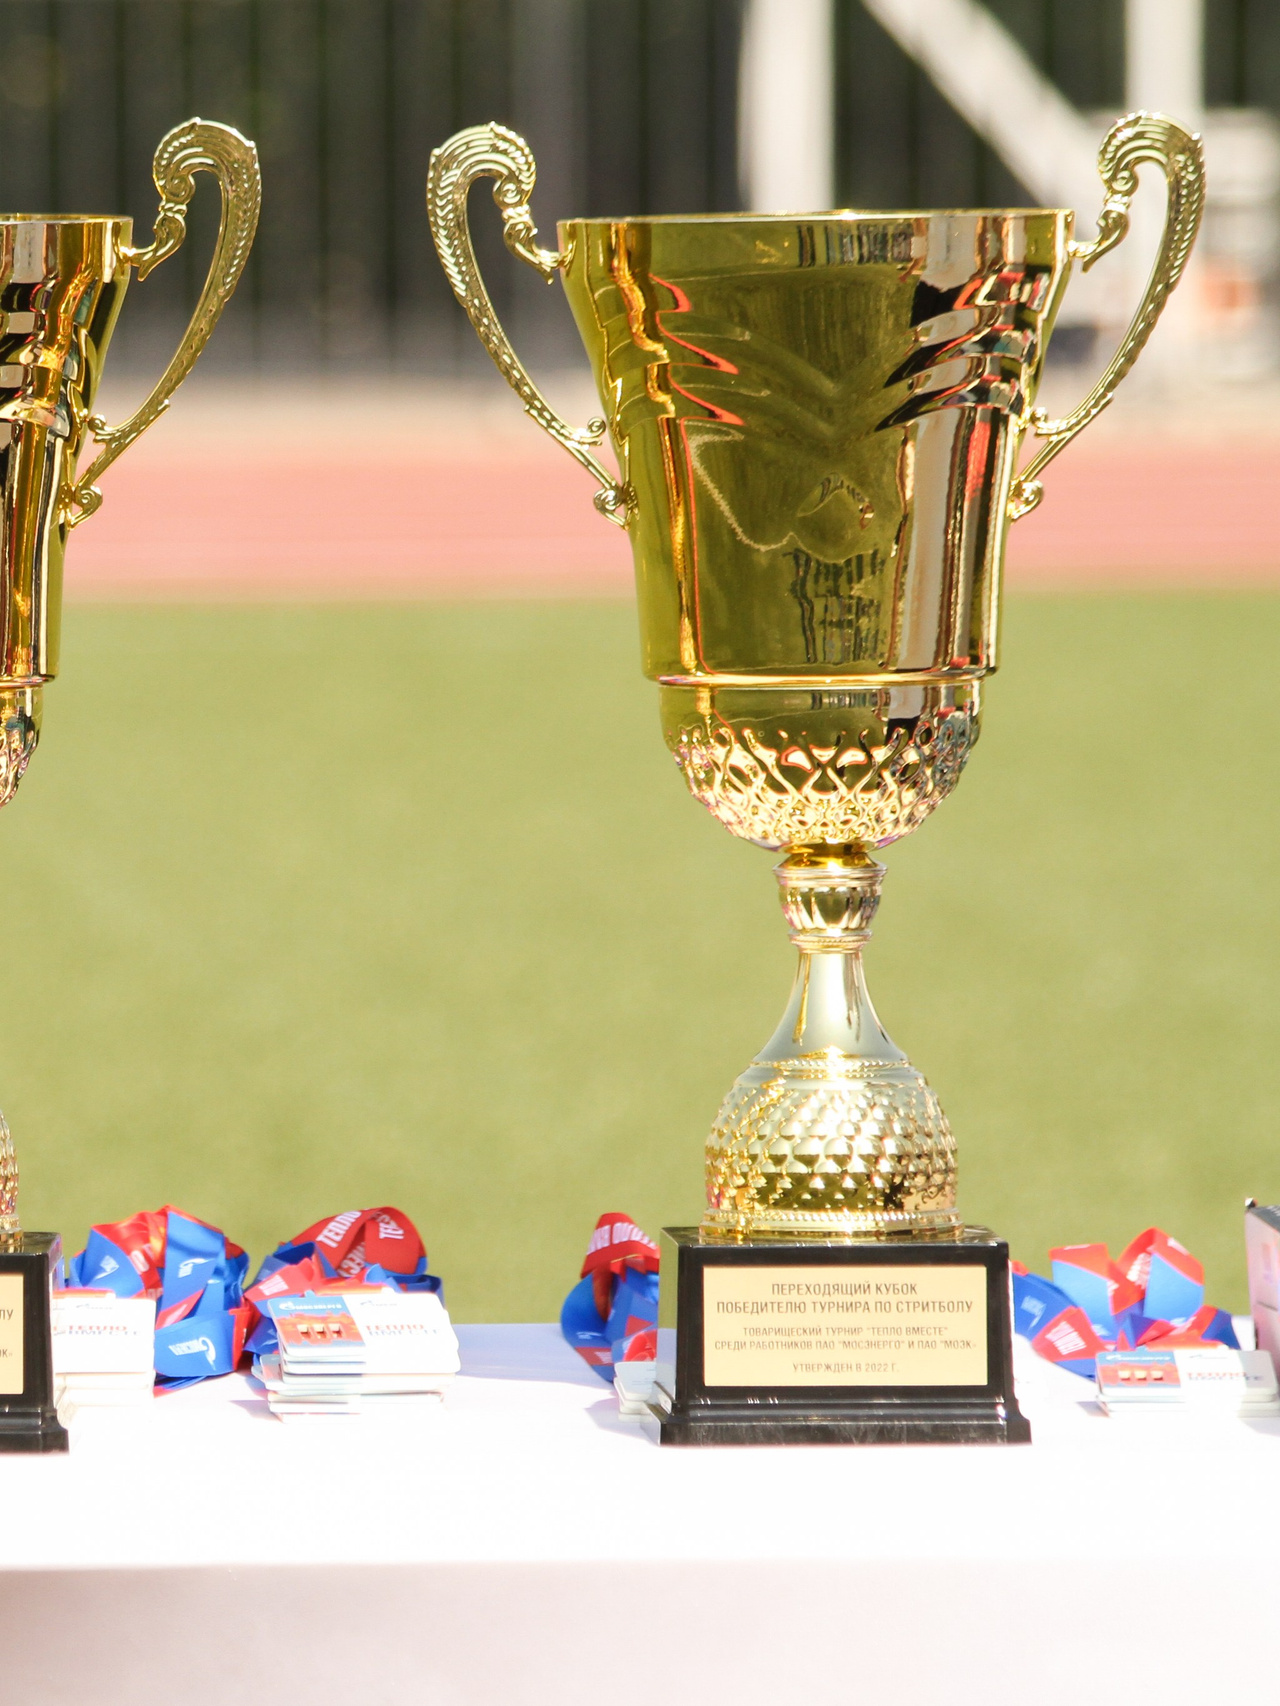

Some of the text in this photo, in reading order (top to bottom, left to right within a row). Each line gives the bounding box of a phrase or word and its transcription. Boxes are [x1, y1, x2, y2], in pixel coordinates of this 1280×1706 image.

[772, 1281, 917, 1296] ПЕРЕХОДЯЩИЙ КУБОК
[717, 1300, 973, 1314] ПОБЕДИТЕЛЮ ТУРНИРА ПО СТРИТБОЛУ
[743, 1325, 948, 1337] ТОВАРИЩЕСКИЙ ТУРНИР "ТЕПЛО ВМЕСТЕ"
[715, 1340, 747, 1351] СРЕДИ
[750, 1340, 813, 1350] РАБОТНИКОВ
[815, 1340, 835, 1350] ПАО
[908, 1340, 915, 1349] И
[917, 1340, 937, 1350] ПАО
[793, 1363, 853, 1374] УТВЕРЖДЕН
[856, 1363, 861, 1372] В
[865, 1363, 889, 1372] 2022
